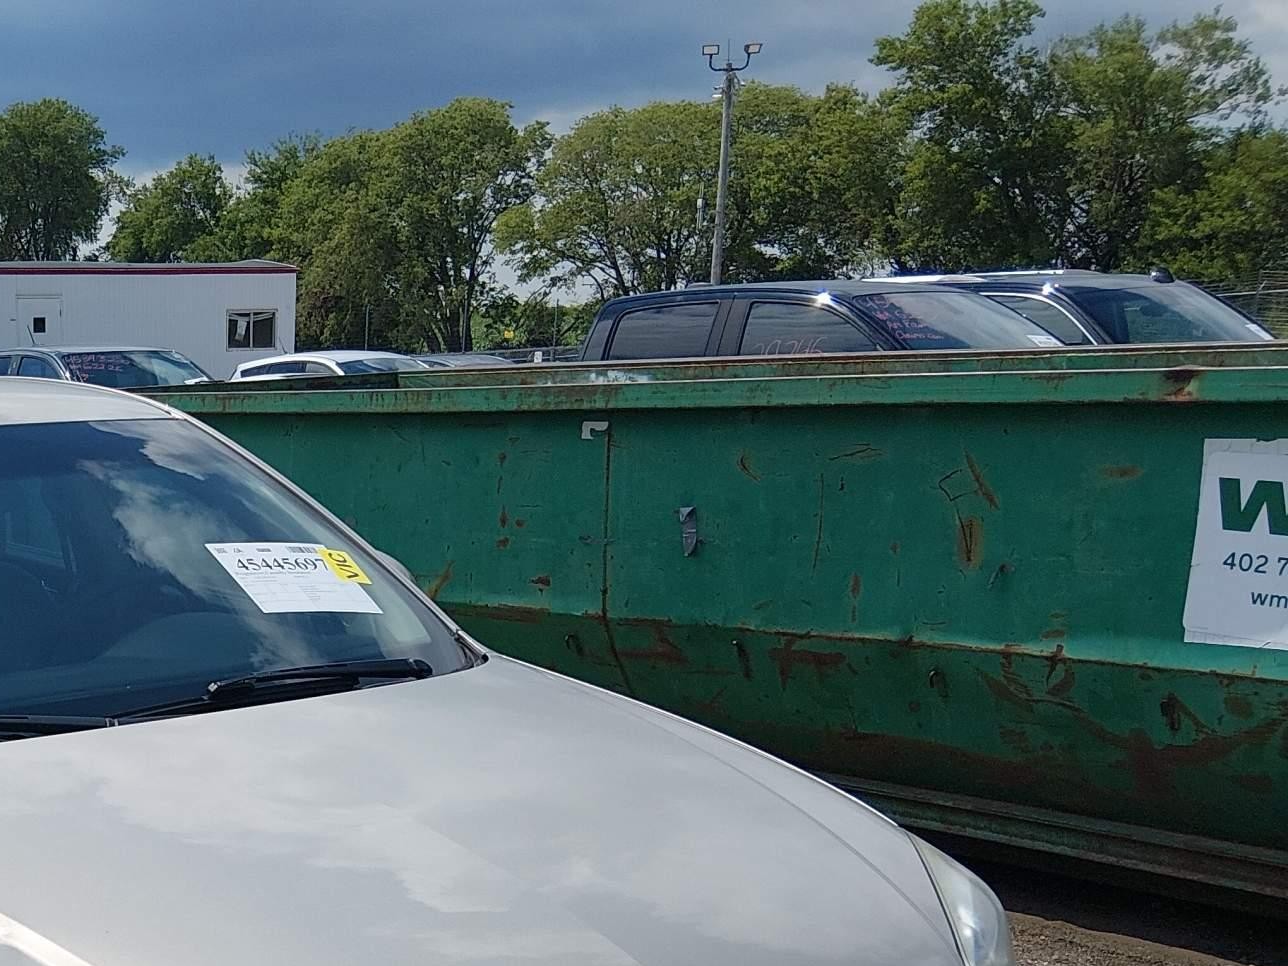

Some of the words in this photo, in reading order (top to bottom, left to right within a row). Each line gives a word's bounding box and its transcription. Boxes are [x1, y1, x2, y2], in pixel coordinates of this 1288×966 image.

[237, 557, 329, 572] 45445697
[327, 552, 360, 579] VIC
[1223, 552, 1268, 574] 402
